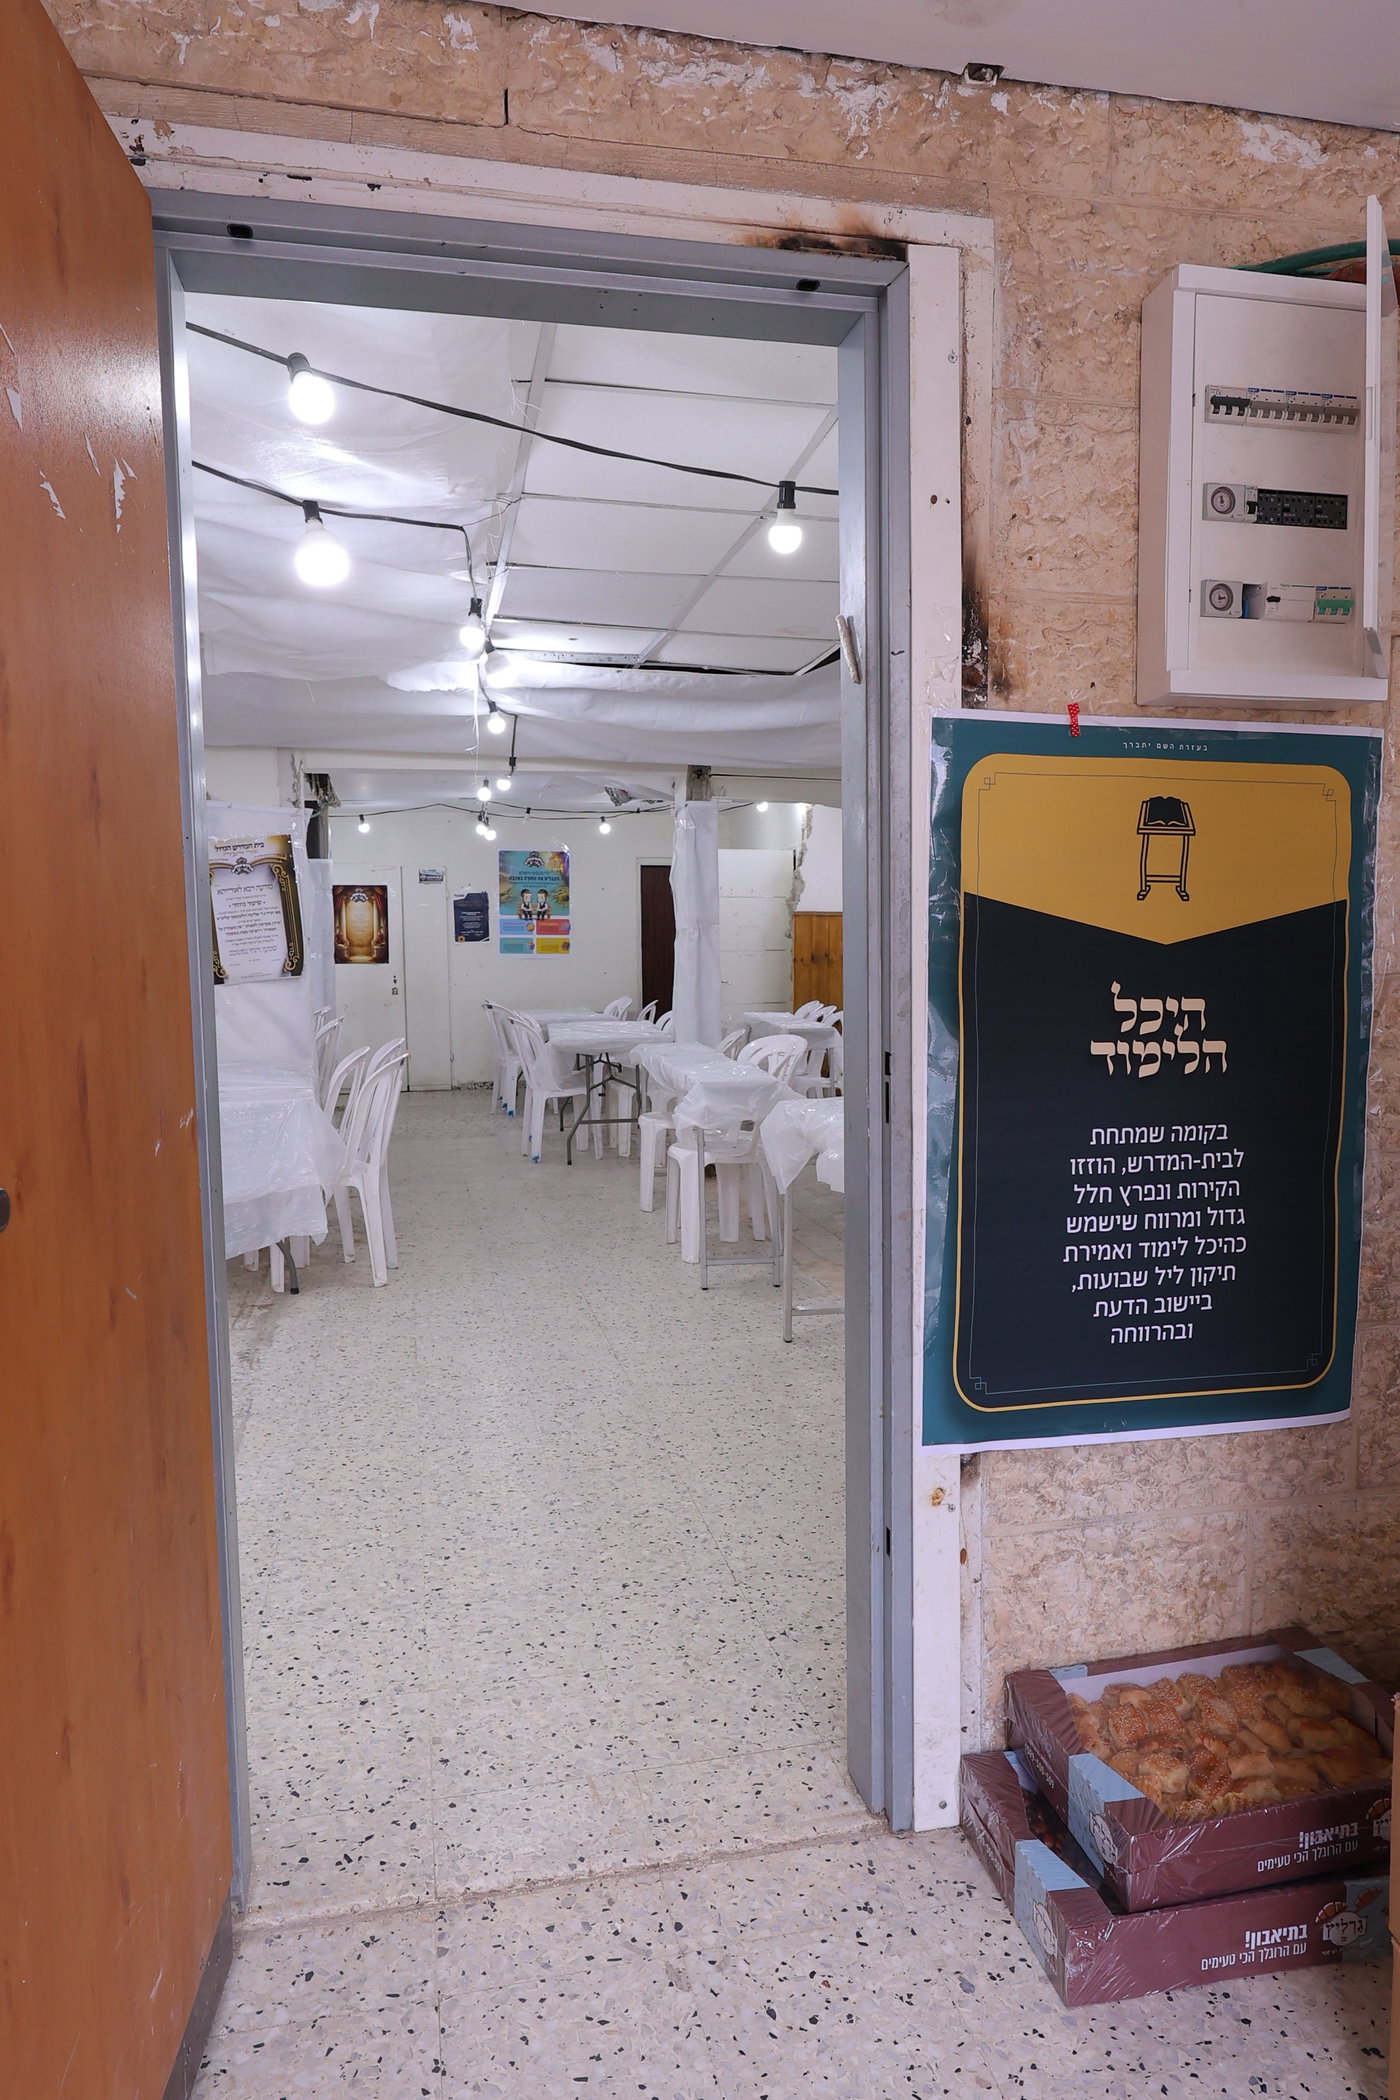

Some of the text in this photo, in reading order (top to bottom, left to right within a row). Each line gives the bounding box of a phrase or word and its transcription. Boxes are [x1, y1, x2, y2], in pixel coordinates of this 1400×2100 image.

[1179, 744, 1208, 752] בעזרת
[1110, 980, 1206, 1035] היכל
[1090, 1023, 1228, 1078] הלימוד
[1090, 1123, 1228, 1145] בקומה שמתחת
[1070, 1148, 1245, 1175] לבית-המדרש, הוזזו
[1073, 1180, 1240, 1206] הקירות ונפרץ חלל
[1066, 1207, 1246, 1233] גדול ומרווח שישמש
[1063, 1235, 1247, 1263] כהיכל לימוד ואמירת
[1071, 1265, 1236, 1293] תיקון ליל שבועות,
[1093, 1294, 1213, 1318] ביישוב הדעת
[1110, 1323, 1193, 1344] ובהרווחה
[1298, 1822, 1359, 1850] בתיאבון!
[1257, 1839, 1358, 1873] עם הרוגלך הכי טעימים
[1245, 1924, 1308, 1950] בתיאבון!
[1201, 1942, 1307, 1971] עם הרוגלך הכי טעימים
